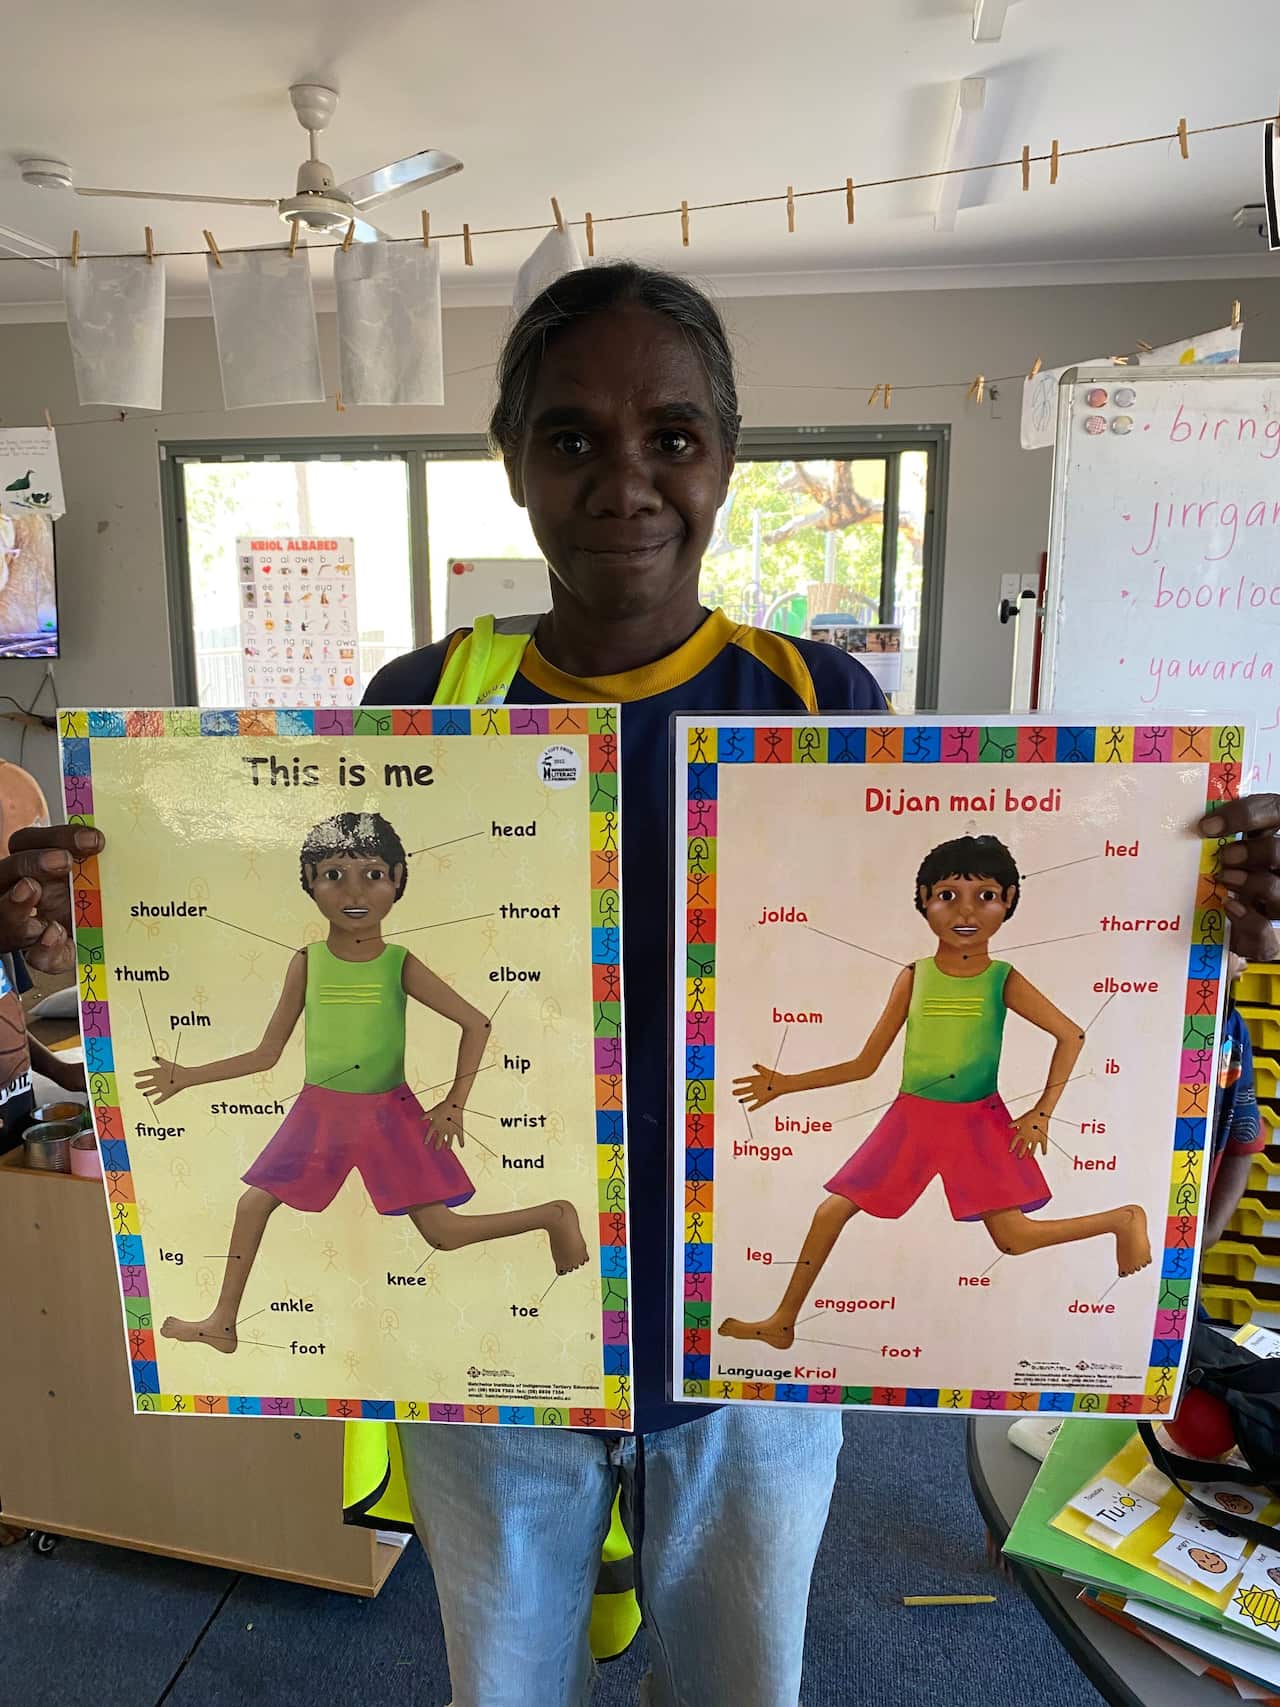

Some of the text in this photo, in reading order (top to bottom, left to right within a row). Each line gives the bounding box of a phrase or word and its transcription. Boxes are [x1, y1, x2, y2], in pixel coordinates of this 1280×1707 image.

[251, 541, 337, 550] KRIOL ALBABED
[242, 754, 435, 788] This is me
[864, 786, 1062, 816] Dijan mai bodi
[491, 820, 537, 838] head
[1104, 840, 1140, 858] hed
[130, 900, 208, 918] shoulder
[498, 902, 561, 920] throat
[758, 906, 809, 925] jolda
[1100, 915, 1181, 932] tharrod
[114, 965, 170, 982] thumb
[488, 966, 542, 983] elbow
[1092, 976, 1159, 993] elbowe
[169, 1010, 212, 1031] palm
[772, 1006, 824, 1025] baam
[503, 1053, 532, 1075] hip
[1104, 1058, 1121, 1075] ib
[210, 1099, 285, 1116] stomach
[499, 1112, 548, 1129] wrist
[774, 1115, 833, 1136] binjee
[1080, 1118, 1106, 1135] ris
[134, 1121, 187, 1141] finger
[732, 1140, 794, 1162] bingga
[501, 1153, 546, 1170] hand
[1072, 1155, 1118, 1172] hend
[159, 1247, 185, 1266] leg
[746, 1247, 773, 1266] leg
[386, 1270, 428, 1288] knee
[958, 1274, 991, 1288] nee
[269, 1297, 315, 1313] ankle
[510, 1303, 540, 1319] toe
[814, 1295, 897, 1314] enggoorl
[1067, 1299, 1117, 1315] dowe
[289, 1339, 327, 1356] foot
[880, 1344, 924, 1359] foot
[717, 1363, 838, 1382] Language Kriol
[1096, 1505, 1126, 1523] Tu
